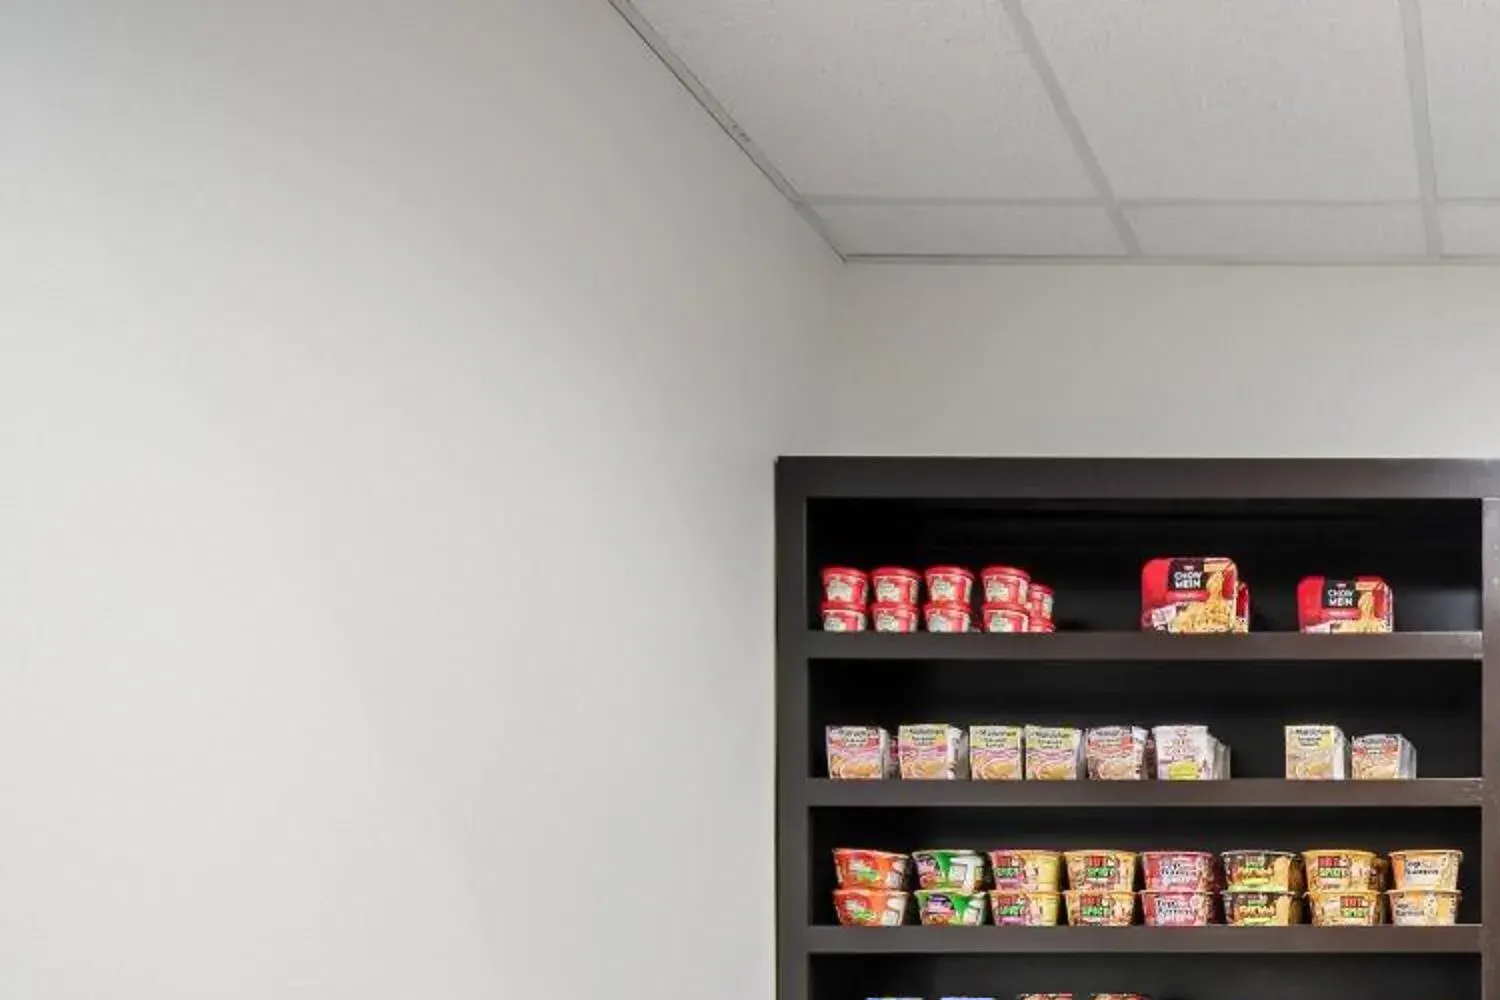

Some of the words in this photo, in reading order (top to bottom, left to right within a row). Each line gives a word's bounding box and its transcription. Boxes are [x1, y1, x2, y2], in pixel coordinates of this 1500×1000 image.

[1173, 571, 1202, 580] CHOW
[1175, 579, 1201, 588] MEIN
[1327, 589, 1354, 598] CHOW
